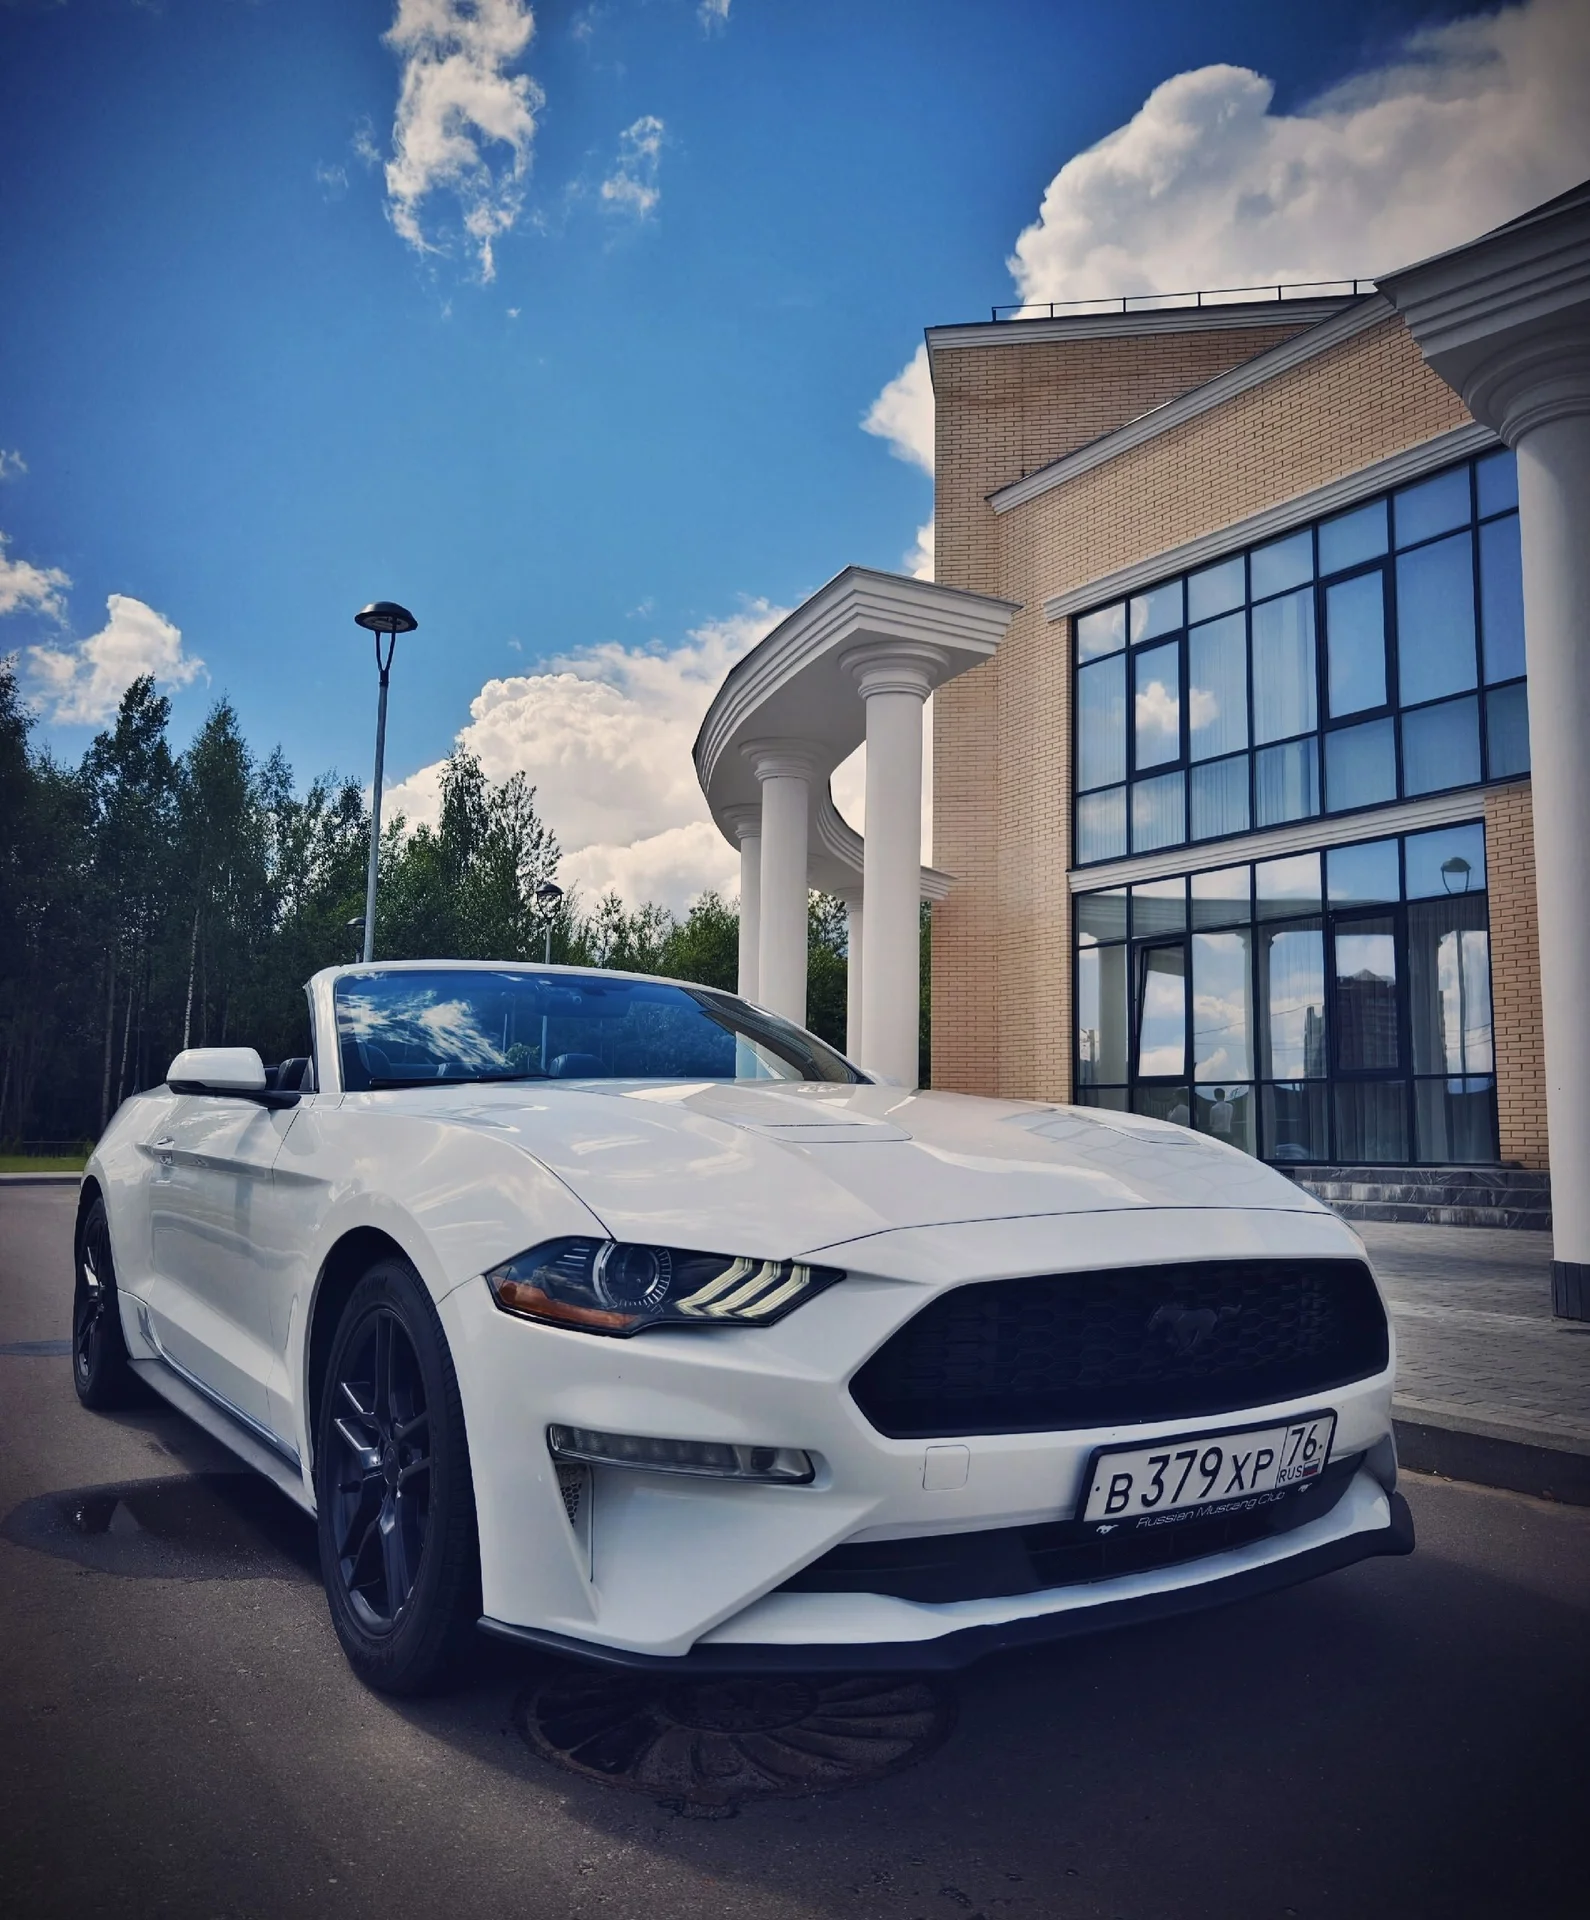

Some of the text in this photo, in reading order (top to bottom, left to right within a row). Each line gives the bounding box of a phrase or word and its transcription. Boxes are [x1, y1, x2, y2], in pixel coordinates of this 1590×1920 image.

[1287, 1423, 1318, 1466] 76
[1278, 1465, 1303, 1483] RUS
[1136, 1491, 1286, 1529] Russian Mustang Club
